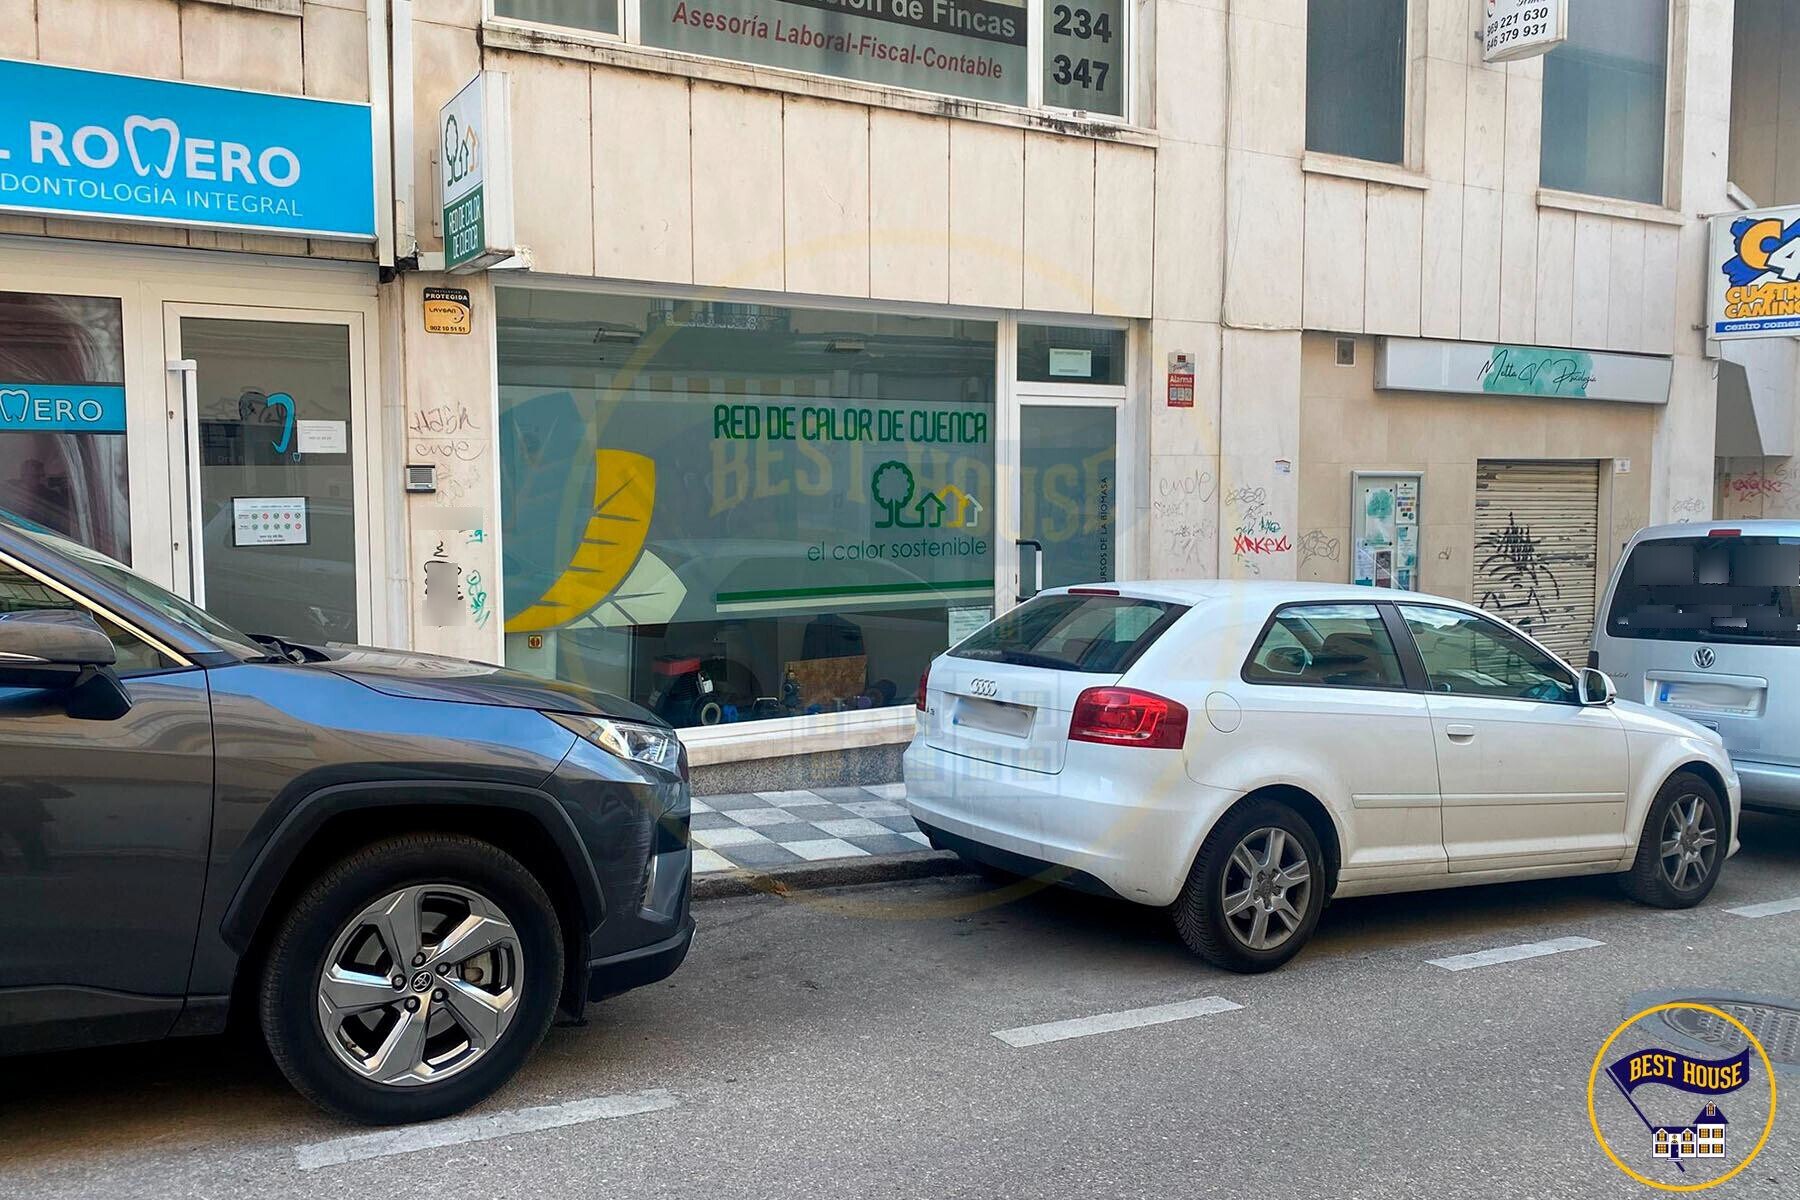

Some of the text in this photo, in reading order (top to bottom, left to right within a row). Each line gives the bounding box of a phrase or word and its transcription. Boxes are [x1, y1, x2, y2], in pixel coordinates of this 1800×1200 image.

[933, 0, 1017, 37] Fincas
[1053, 4, 1112, 43] 234
[1500, 13, 1519, 29] 221
[1523, 7, 1548, 22] 630
[672, 2, 1003, 79] Asesoría Laboral-Fiscal-Contable
[1500, 28, 1519, 44] 379
[1523, 22, 1547, 37] 931
[1053, 54, 1110, 91] 347
[29, 114, 301, 188] ROMERO
[187, 190, 304, 217] INTEGRAL
[448, 195, 481, 236] RED DE CALOR
[453, 234, 460, 260] DE
[425, 293, 468, 301] PROTEGIDA
[1724, 323, 1761, 331] centro
[1170, 374, 1193, 384] Alarma
[714, 404, 987, 443] RED DE CALOR DE CUENCA
[1100, 476, 1108, 520] BIOMASA
[1100, 521, 1108, 534] LA
[807, 537, 987, 562] el calor sostenible
[1100, 535, 1108, 550] DE
